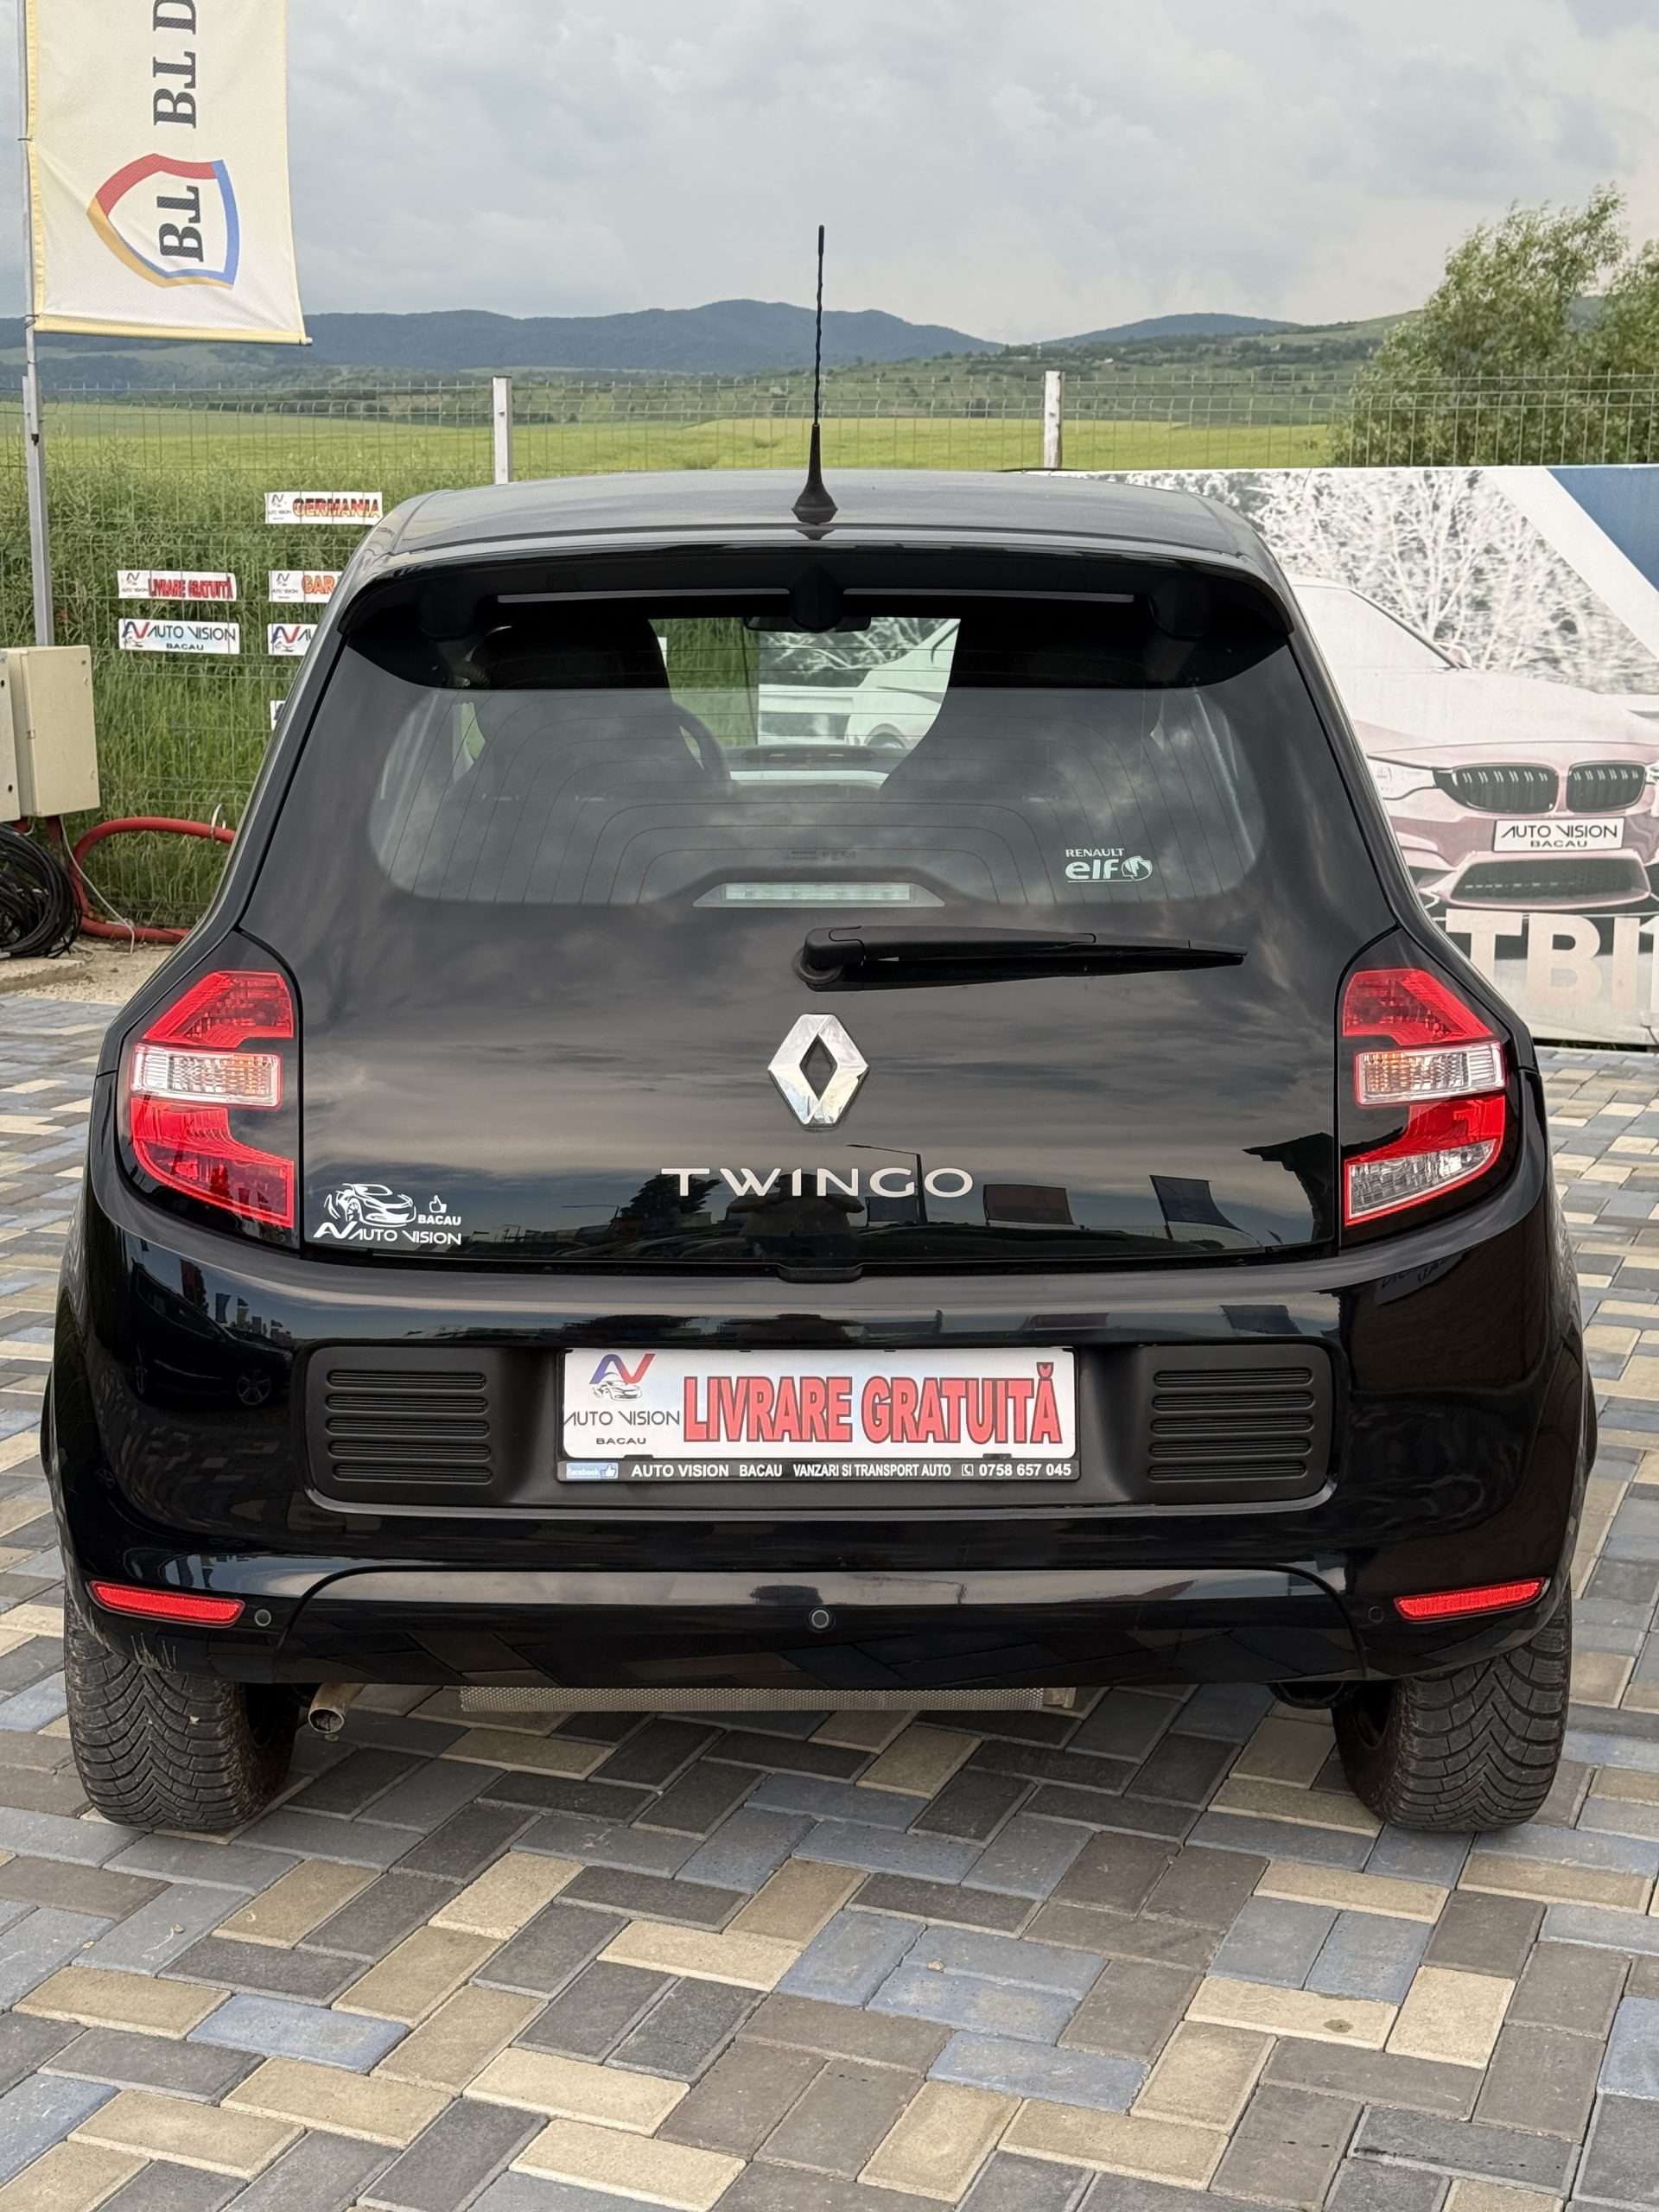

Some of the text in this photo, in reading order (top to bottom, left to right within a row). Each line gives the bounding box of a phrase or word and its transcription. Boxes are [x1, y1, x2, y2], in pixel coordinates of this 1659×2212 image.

[292, 498, 380, 518] GERMANIA
[302, 575, 340, 594] GAR
[147, 626, 236, 641] AUTO VISION
[166, 642, 204, 651] BACAU
[1501, 824, 1618, 838] AUTO VISION
[1065, 849, 1124, 857] RENAULT
[1065, 859, 1119, 880] elf
[661, 1167, 974, 1198] TWINGO
[418, 1214, 461, 1225] BACAU
[348, 1228, 461, 1245] AUTO VISION
[683, 1362, 1063, 1444] LIVRARE GRATUITĂ
[563, 1410, 680, 1426] AUTO VISION
[631, 1464, 1071, 1477] AUTO VISION BACAU VANZARI SI TRANSPORT AUTO 0758 657 045
